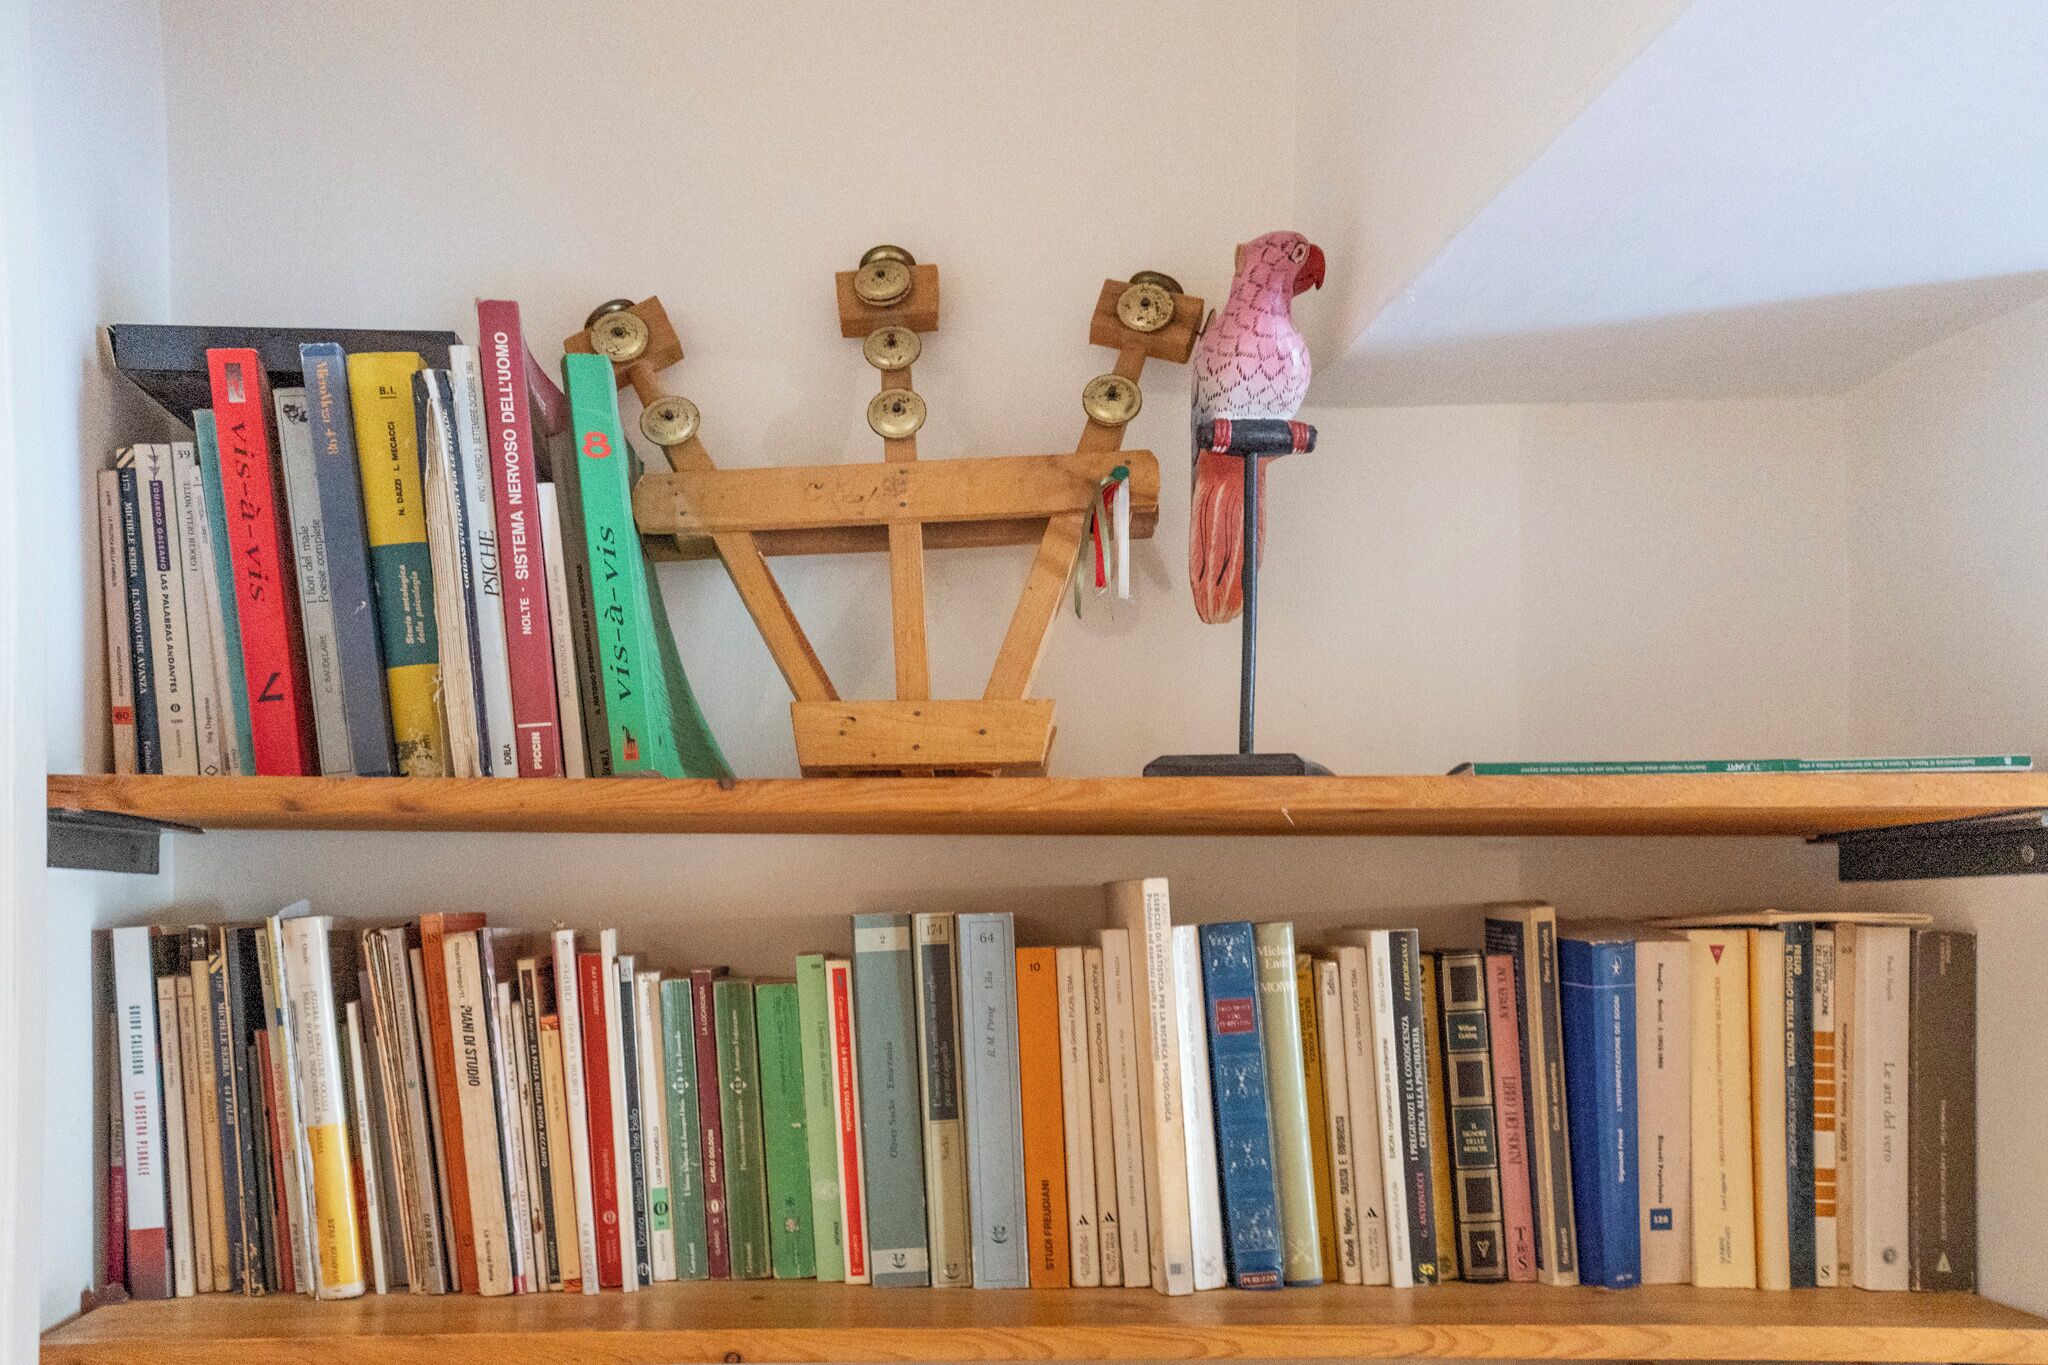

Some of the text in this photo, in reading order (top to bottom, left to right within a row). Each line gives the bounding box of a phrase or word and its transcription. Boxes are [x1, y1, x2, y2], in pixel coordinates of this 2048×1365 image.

[387, 420, 403, 503] DAZZI MECACCI
[466, 375, 486, 501] ANNO NUMERO SETTEMBRE-DICEMBRE
[580, 431, 612, 458] 8
[494, 332, 532, 634] NOLTE SISTEMA NERVOSO DELL'UOMO
[182, 480, 197, 566] GIOCHI DELLA NOTTE
[230, 421, 269, 601] vis-à-vis
[450, 469, 470, 588] GRIDAS L'UTOPIA PER
[297, 525, 313, 571] del male
[310, 518, 329, 602] Poesie complete
[477, 529, 499, 596] PSICHE
[124, 502, 147, 694] MICHELE SERRA IL NUOVO CHE AVANZA
[151, 482, 177, 692] EDUARDO GALEANO LAS PALABRAS ANDANTES
[397, 564, 414, 644] Storia antologica
[410, 570, 425, 642] della psicologia
[593, 525, 632, 701] vis-à-vis
[318, 634, 332, 682] BAUDELAIRE
[576, 563, 599, 706] METODO SPERIMENTALE PSICOLOGIA
[502, 743, 511, 764] BORLA
[530, 731, 543, 769] PICCIN
[979, 932, 993, 943] 64
[1145, 893, 1153, 930] Problemi
[1152, 893, 1160, 929] ESERCIZI
[1155, 932, 1161, 940] DI
[192, 937, 205, 947] 24
[1029, 962, 1040, 971] 10
[1148, 946, 1156, 977] esercizi
[1155, 943, 1164, 991] STATISTICA
[1257, 946, 1290, 957] Micha
[1541, 927, 1551, 983] Piero Angela
[1793, 943, 1801, 976] FREUD
[984, 970, 993, 989] Lila
[1091, 963, 1100, 1014] DECAMERONE
[1261, 982, 1291, 993] MOM
[1400, 943, 1410, 1001] FATAMORGANA
[129, 1005, 141, 1029] GUIDO
[200, 1005, 209, 1049] MARGUERITE
[698, 986, 707, 1035] LA LOCANDIERA
[985, 1005, 996, 1031] Pirsig
[1159, 1011, 1166, 1021] LA
[1612, 994, 1620, 1020] SOGNI
[1784, 943, 1795, 1067] IL DISAGIO DELLA CIVILTÀ
[217, 1001, 229, 1077] MICHELE SERRA
[302, 991, 320, 1112] NELLA INDUSTRIALE
[310, 990, 328, 1111] POTERE STRUTTURE SOCIALI
[459, 1004, 480, 1086] PIANI DI STUDIO
[1152, 1012, 1160, 1061] commentati
[1160, 1024, 1168, 1058] RICERCA
[1401, 1015, 1412, 1077] CONOSCENZA
[526, 998, 547, 1167] Alda Merini LA PAZZA DELLA PORTA ACCANTO
[841, 1046, 851, 1131] LA BRUTTINA STAGIONATA
[1161, 1062, 1171, 1122] PSICOLOGICA
[1405, 1078, 1413, 1091] LA
[1411, 1026, 1426, 1147] CRITICA ALLA PSICHIATRIA
[1549, 1062, 1558, 1103] economia
[1614, 1035, 1623, 1112] L'INTERPRETAZIONE
[886, 1099, 898, 1158] Oliver Sacks
[1406, 1101, 1417, 1154] PREGIUDIZI
[1883, 1061, 1895, 1162] Le del vero
[134, 1104, 149, 1176] DESTRA PLURALE
[629, 1108, 641, 1176] senza fine bello
[652, 1125, 660, 1165] PIRANDELLO
[707, 1128, 715, 1158] GOLDONI
[1338, 1168, 1349, 1194] SUSSI
[1416, 1171, 1426, 1225] ANTONUCCI
[483, 1229, 489, 1237] La
[520, 1190, 529, 1237] CANCELLATI
[1041, 1179, 1054, 1270] STUDI FREUDIANI
